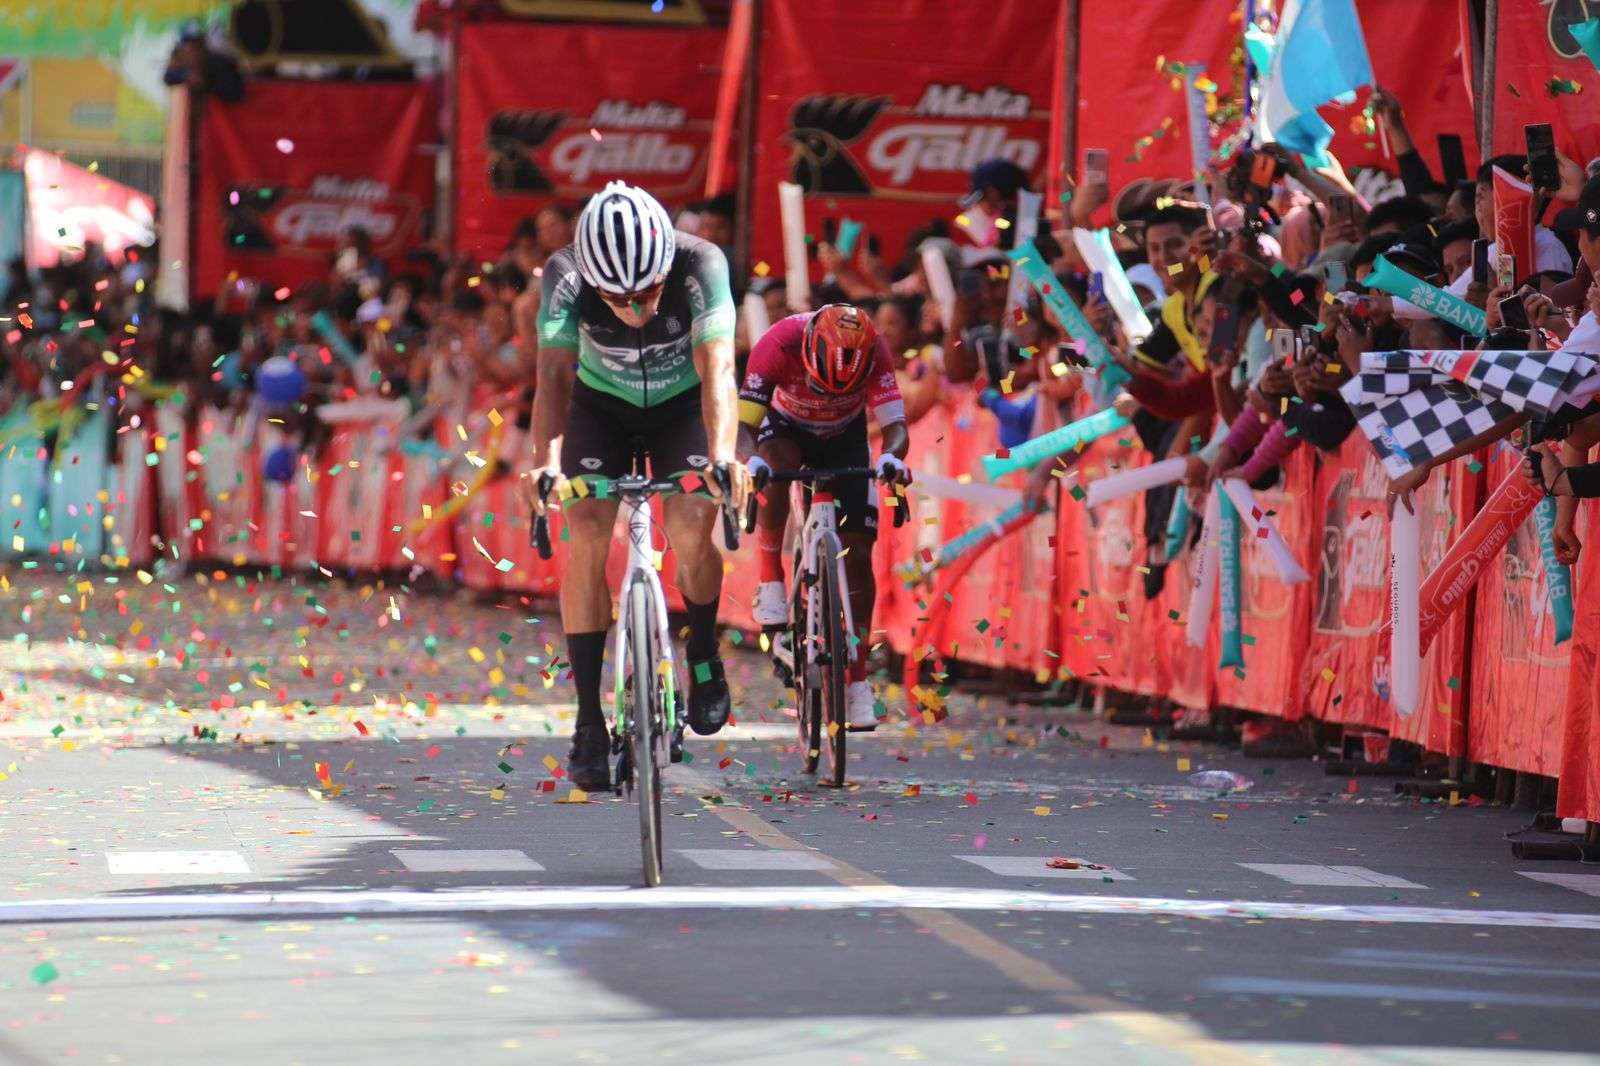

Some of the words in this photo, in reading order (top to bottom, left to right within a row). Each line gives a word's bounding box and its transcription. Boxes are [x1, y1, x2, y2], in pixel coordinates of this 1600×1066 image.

[592, 100, 687, 127] Malta
[916, 84, 1031, 117] Malta
[552, 131, 695, 183] Gallo
[867, 124, 1040, 184] Gallo
